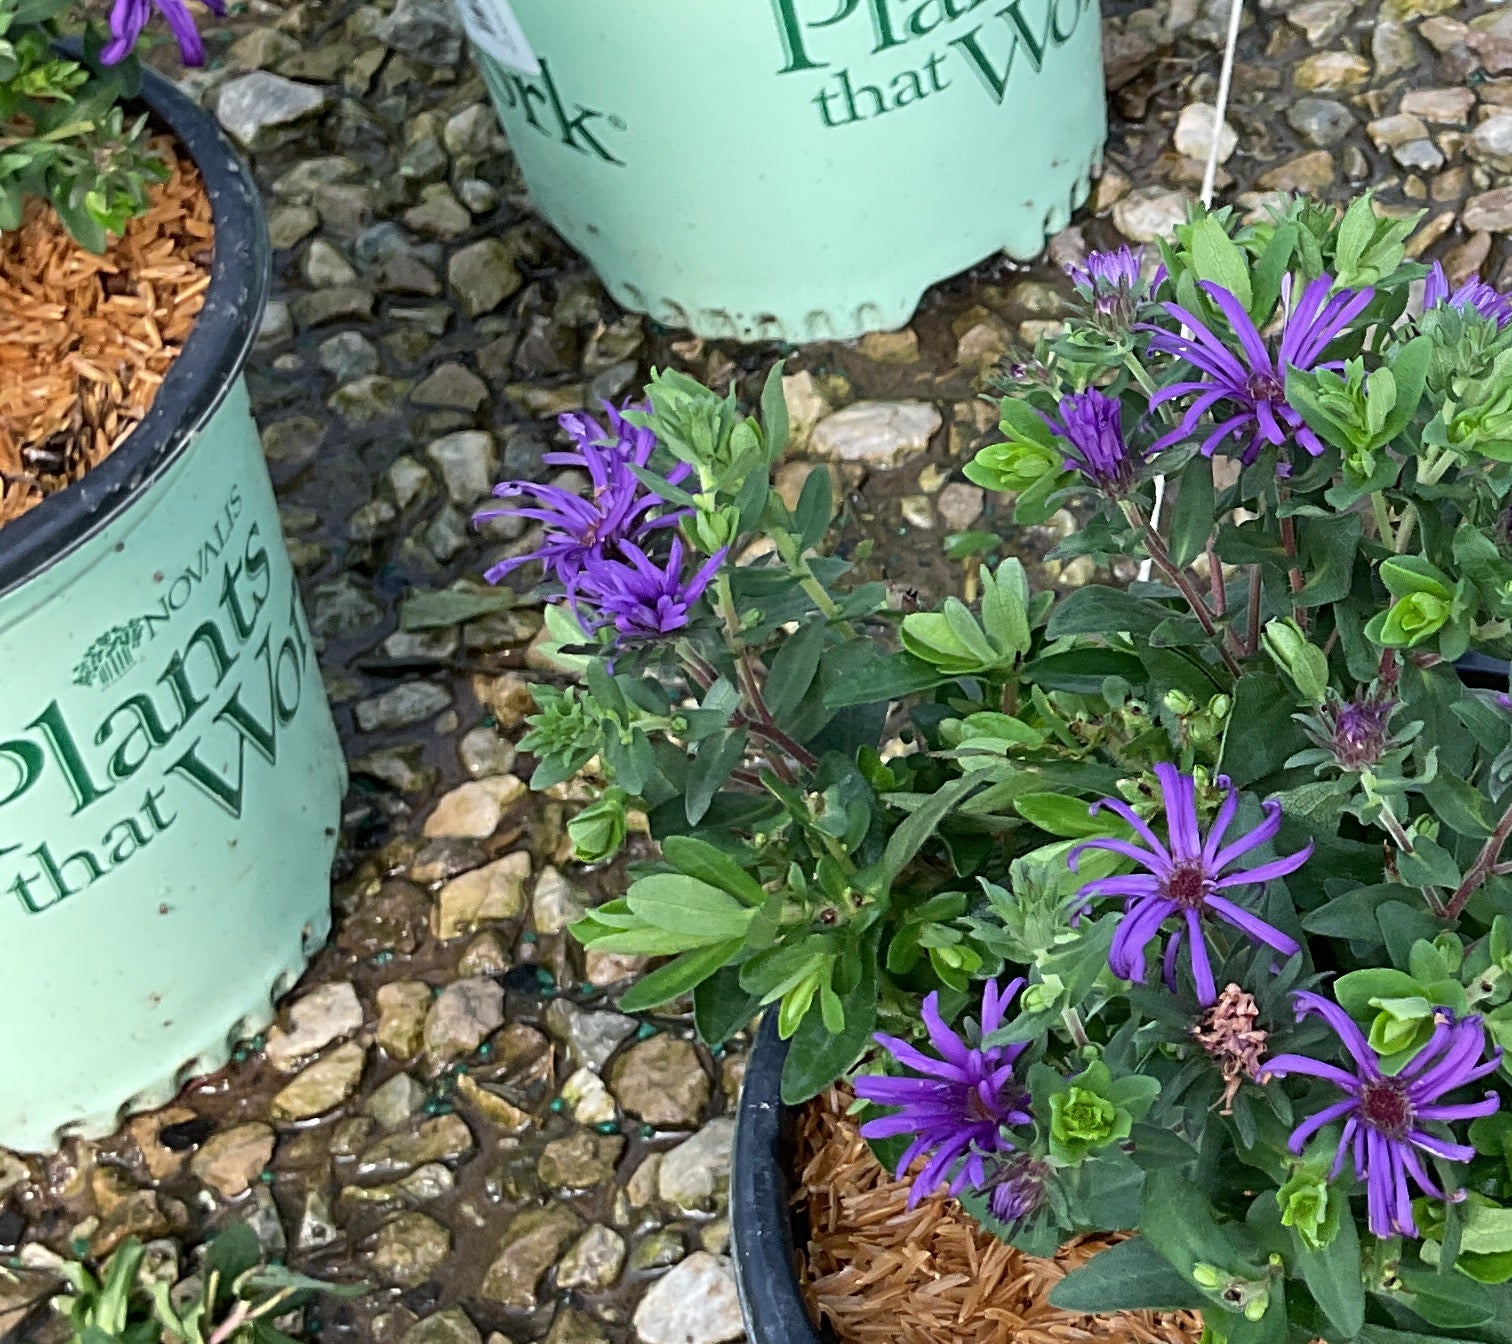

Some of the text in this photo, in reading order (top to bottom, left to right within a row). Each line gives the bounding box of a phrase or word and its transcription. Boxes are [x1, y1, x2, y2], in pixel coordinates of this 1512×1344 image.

[811, 51, 953, 129] that
[142, 483, 243, 642] NOVALIS
[7, 785, 178, 914] that
